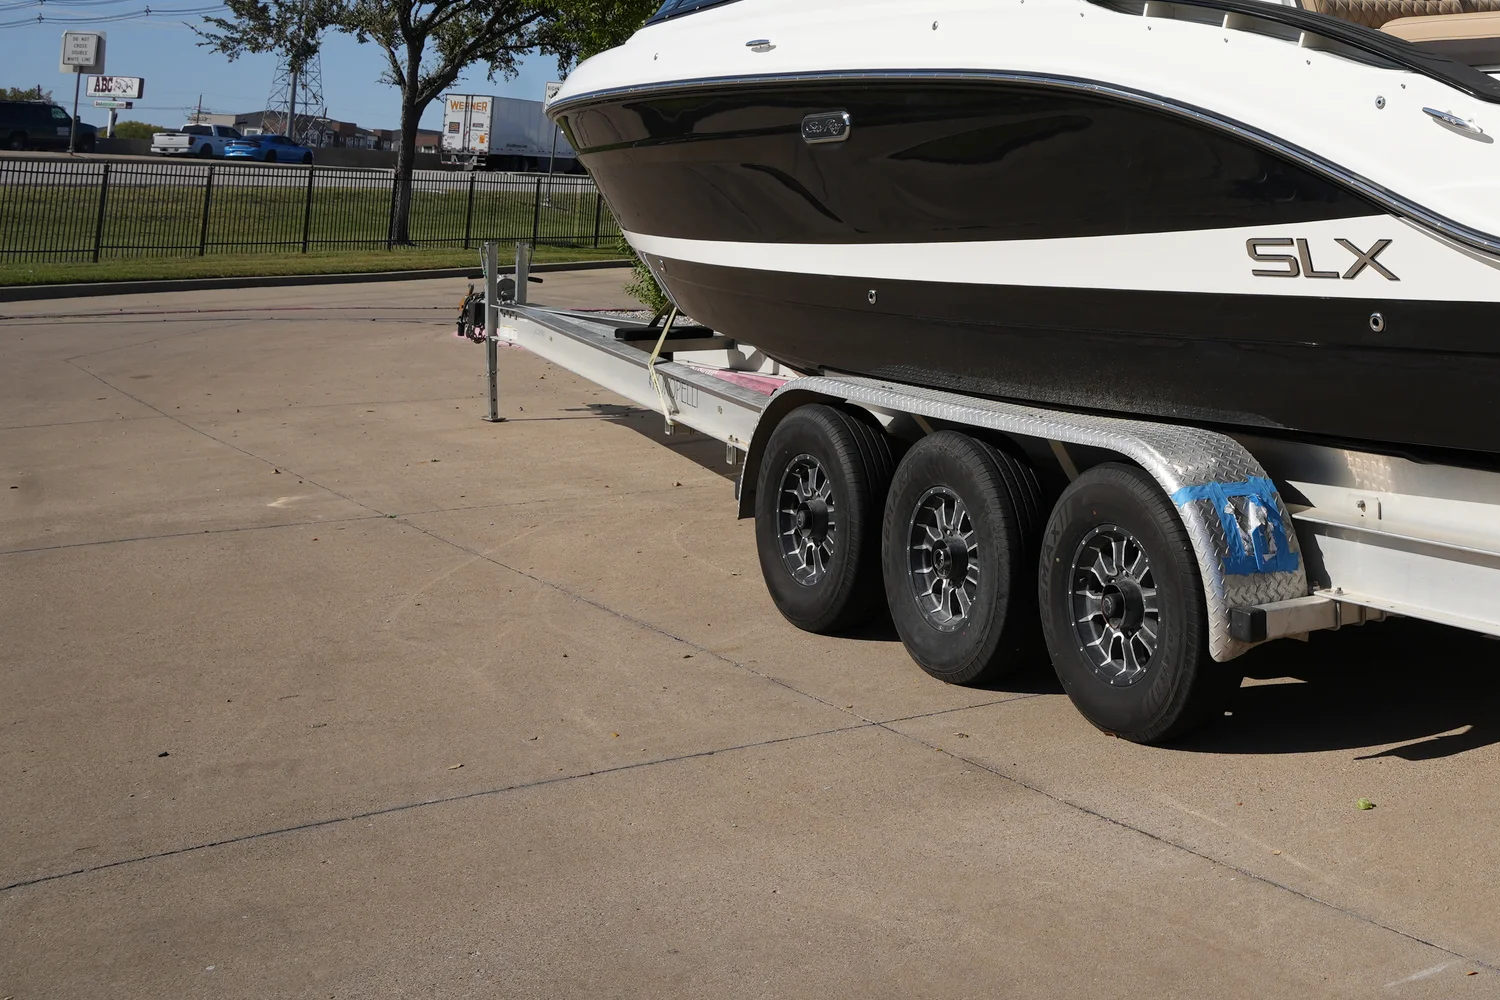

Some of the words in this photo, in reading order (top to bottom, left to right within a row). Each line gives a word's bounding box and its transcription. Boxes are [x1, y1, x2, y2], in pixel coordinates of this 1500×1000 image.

[94, 77, 114, 93] ABC
[450, 100, 488, 112] WERNER
[806, 121, 824, 133] Sea
[1246, 238, 1401, 282] SLX
